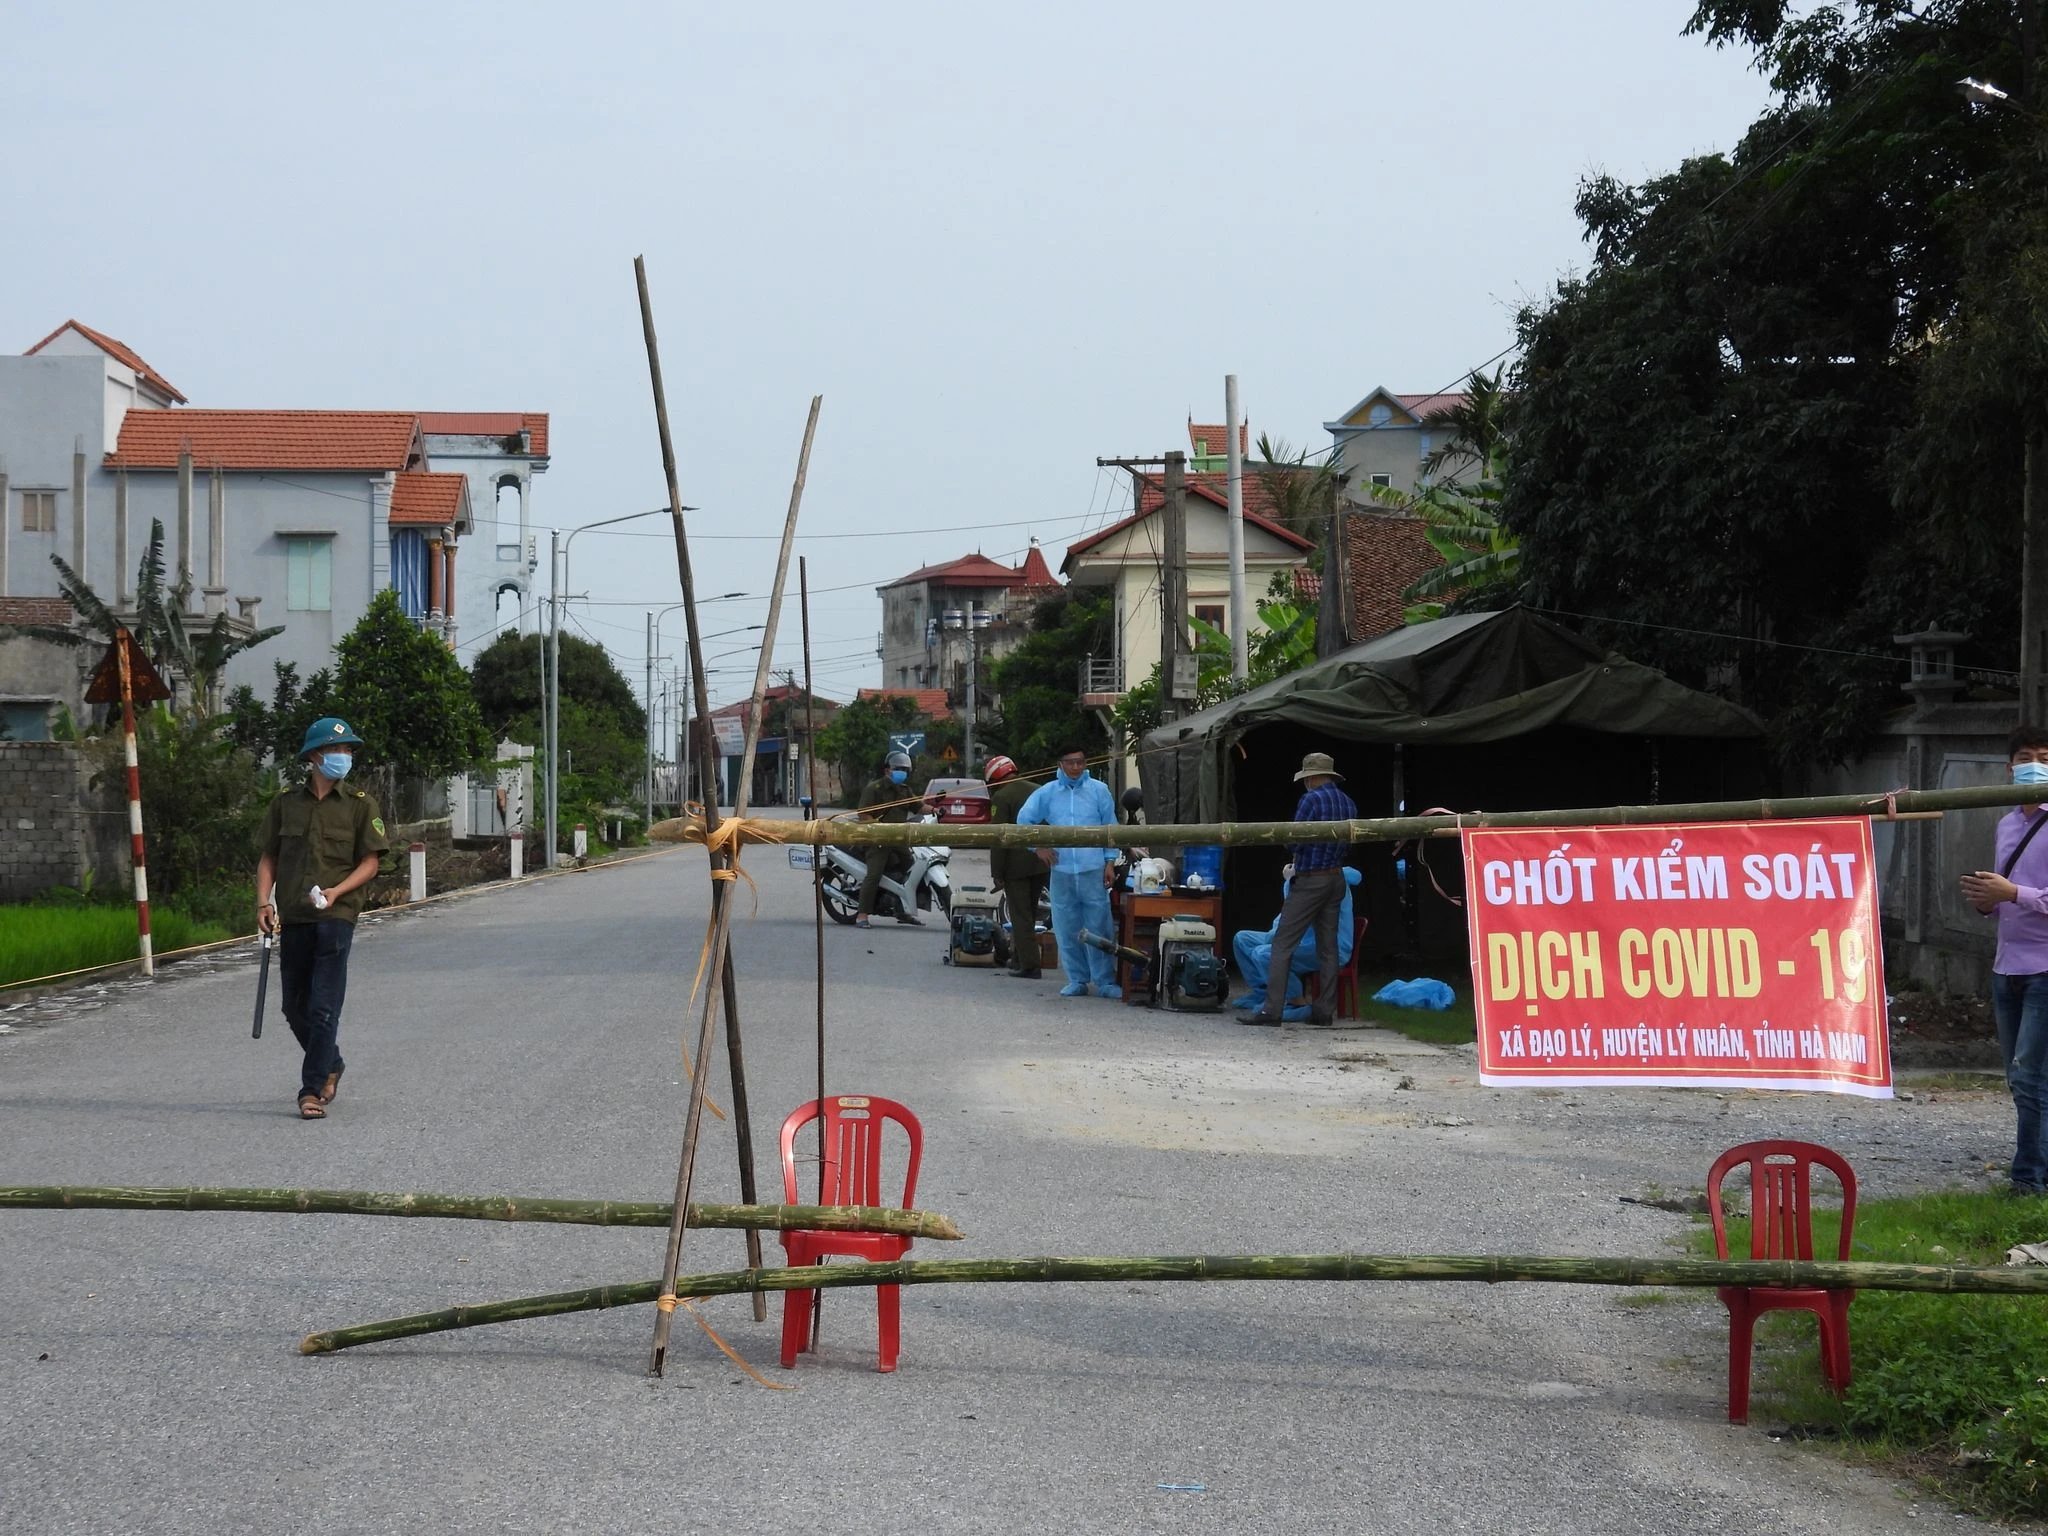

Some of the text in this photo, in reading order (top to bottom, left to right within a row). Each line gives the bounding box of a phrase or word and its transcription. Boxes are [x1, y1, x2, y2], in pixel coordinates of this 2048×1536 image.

[1483, 838, 1856, 905] CHỐT KIỂM SOÁT
[1487, 930, 1605, 1016] DỊCH
[1618, 928, 1763, 998] COVID
[1810, 928, 1867, 1003] 19
[1500, 1020, 1867, 1064] XÃ ĐẠO LÝ, HUYỆN LÝ NHÂN, TỈNH HÀ NAM
